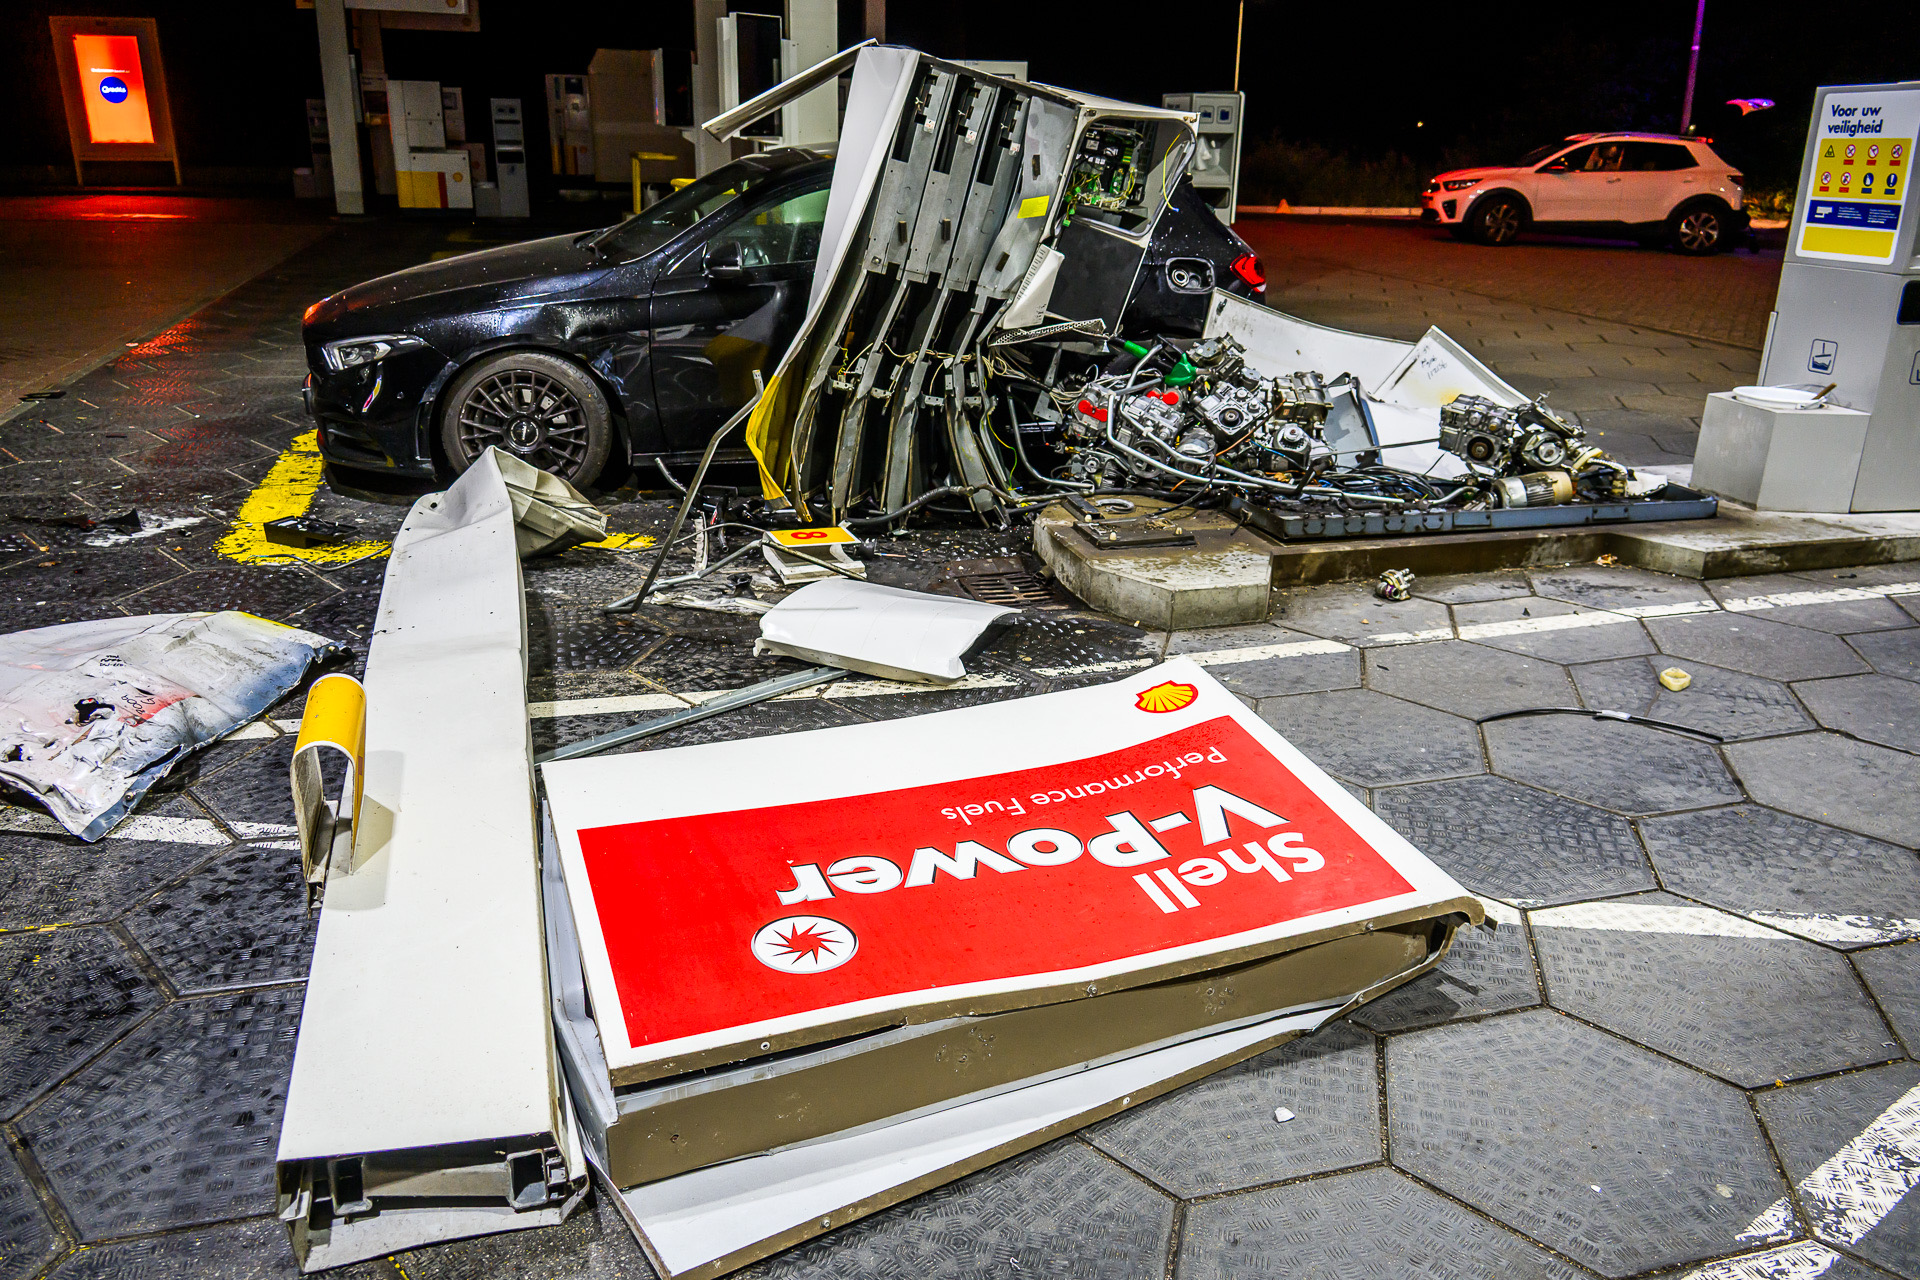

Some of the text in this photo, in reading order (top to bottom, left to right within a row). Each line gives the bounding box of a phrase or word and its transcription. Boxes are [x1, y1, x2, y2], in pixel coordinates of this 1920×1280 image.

[1828, 119, 1883, 137] veiligheid
[1832, 104, 1882, 117] Voor uw
[791, 532, 828, 540] 8
[940, 746, 1228, 825] Performance Fuels
[776, 785, 1291, 905] V-Power
[1131, 831, 1326, 914] Shell
